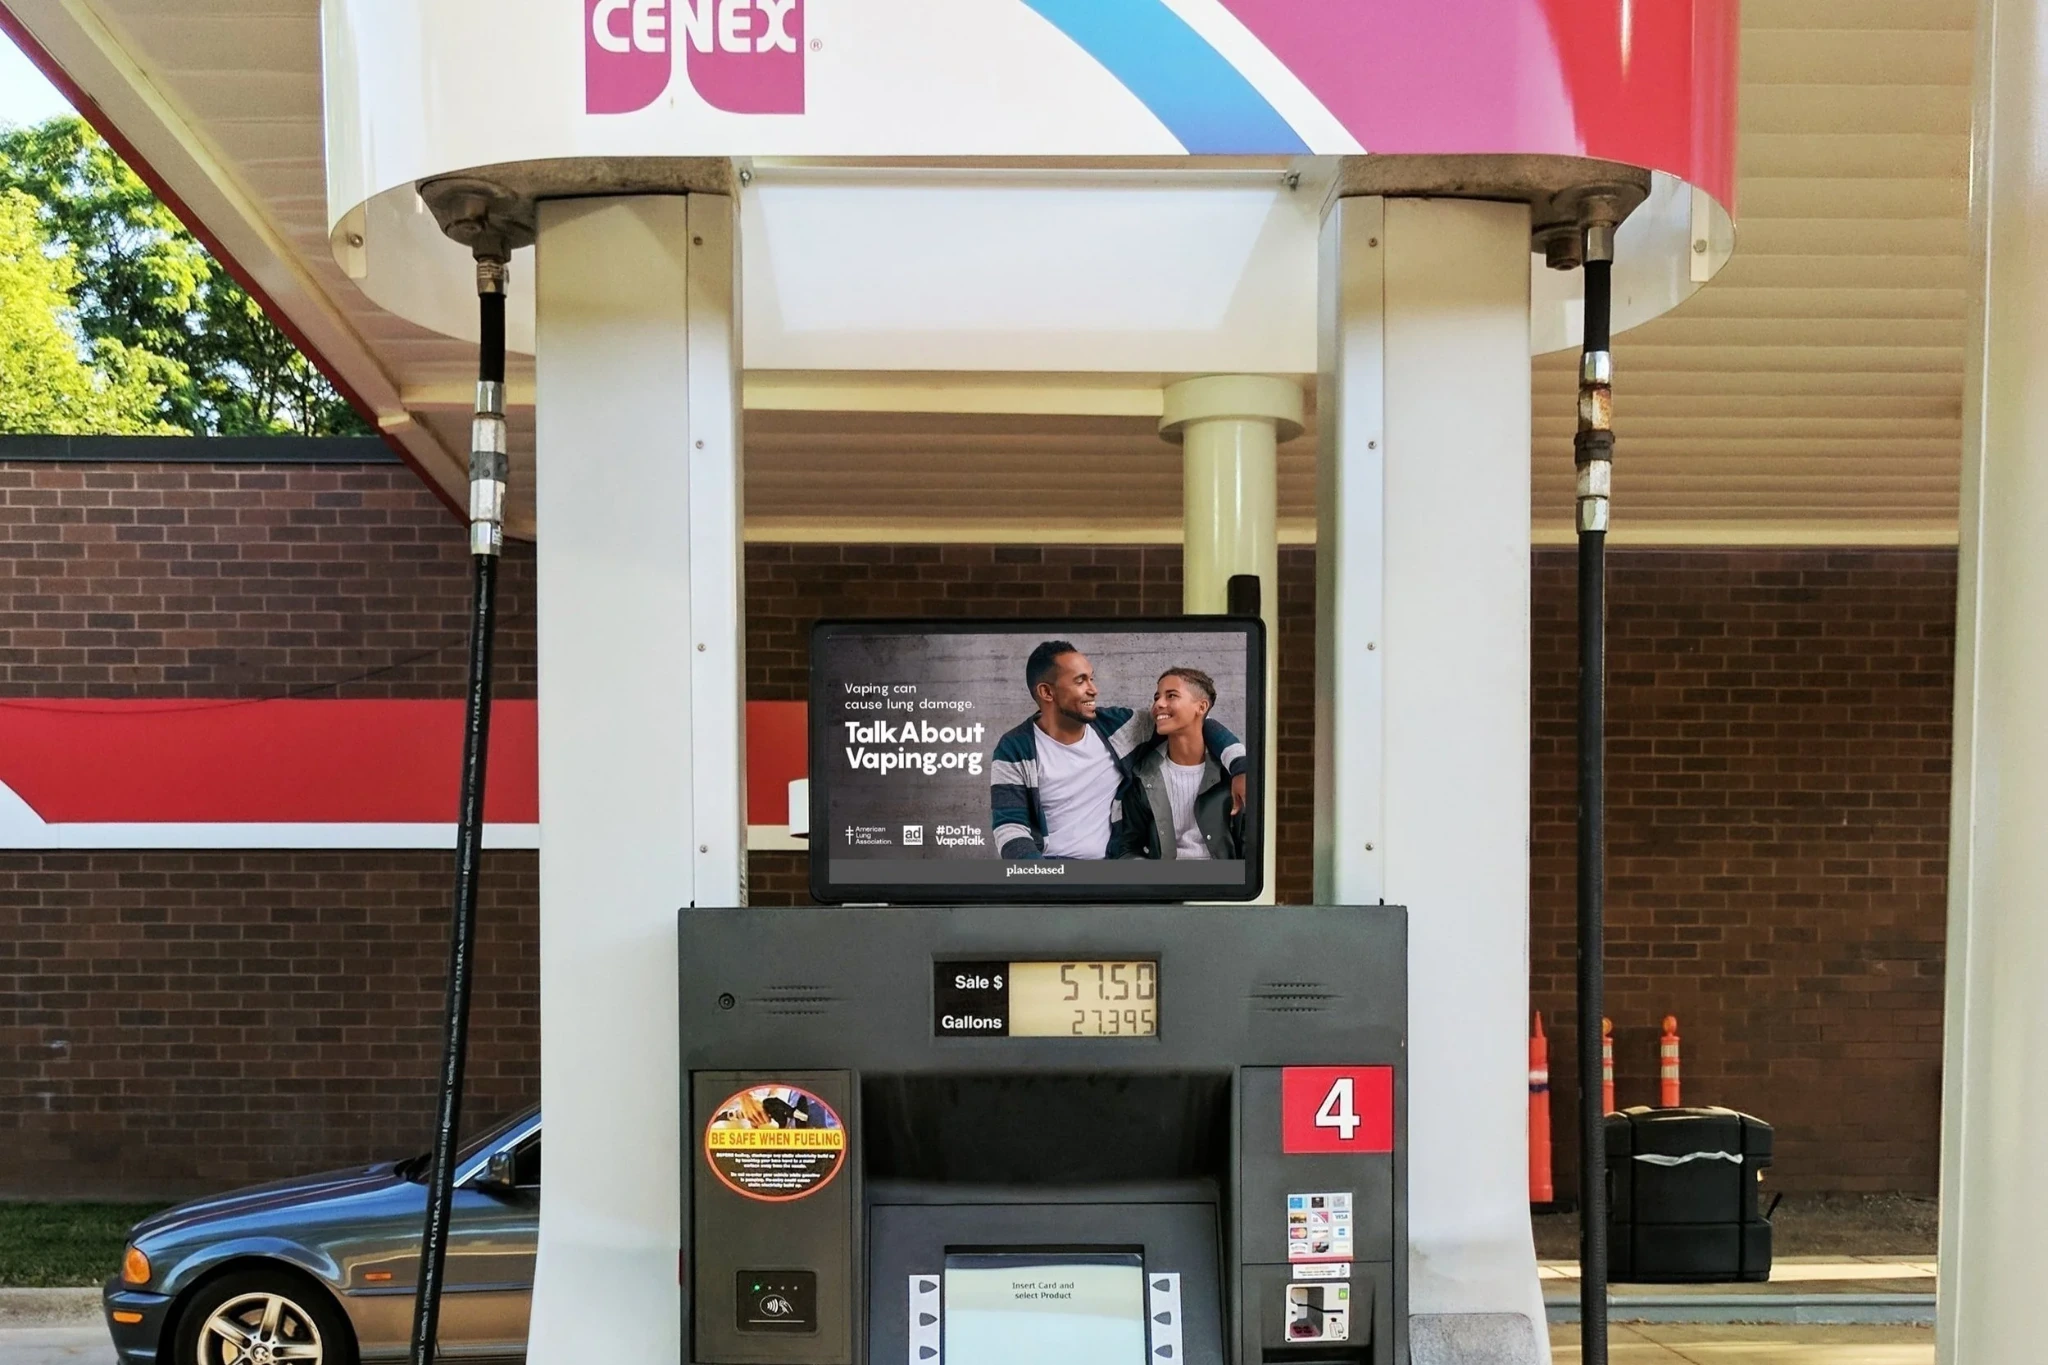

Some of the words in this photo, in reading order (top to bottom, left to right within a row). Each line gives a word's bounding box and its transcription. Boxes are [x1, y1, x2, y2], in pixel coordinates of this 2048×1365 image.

[592, 0, 797, 53] CENEX
[845, 683, 888, 696] Vaping
[893, 685, 917, 694] can
[473, 682, 481, 731] FUTURA
[845, 701, 882, 710] cause
[887, 698, 914, 712] lung
[919, 698, 975, 712] damage.
[845, 747, 983, 776] Vaping.org
[936, 825, 981, 836] #DoThe
[936, 836, 985, 848] VapeTalk
[1006, 864, 1065, 877] placebased
[453, 942, 463, 991] FUTURA
[955, 975, 989, 989] Sale
[993, 974, 1003, 990] $
[1061, 963, 1155, 1001] 57.50
[942, 1015, 1002, 1030] Gallons
[1072, 1009, 1155, 1035] 27.395
[1314, 1077, 1361, 1140] 4
[711, 1132, 725, 1145] BE
[729, 1132, 756, 1145] SAFE
[759, 1132, 790, 1145] WHEN
[795, 1132, 841, 1145] FUELING
[430, 1199, 441, 1248] FUTURA
[1012, 1281, 1035, 1289] Insert
[1038, 1281, 1057, 1289] Card
[1060, 1281, 1074, 1289] and
[1015, 1291, 1038, 1299] select
[1041, 1291, 1072, 1299] Product
